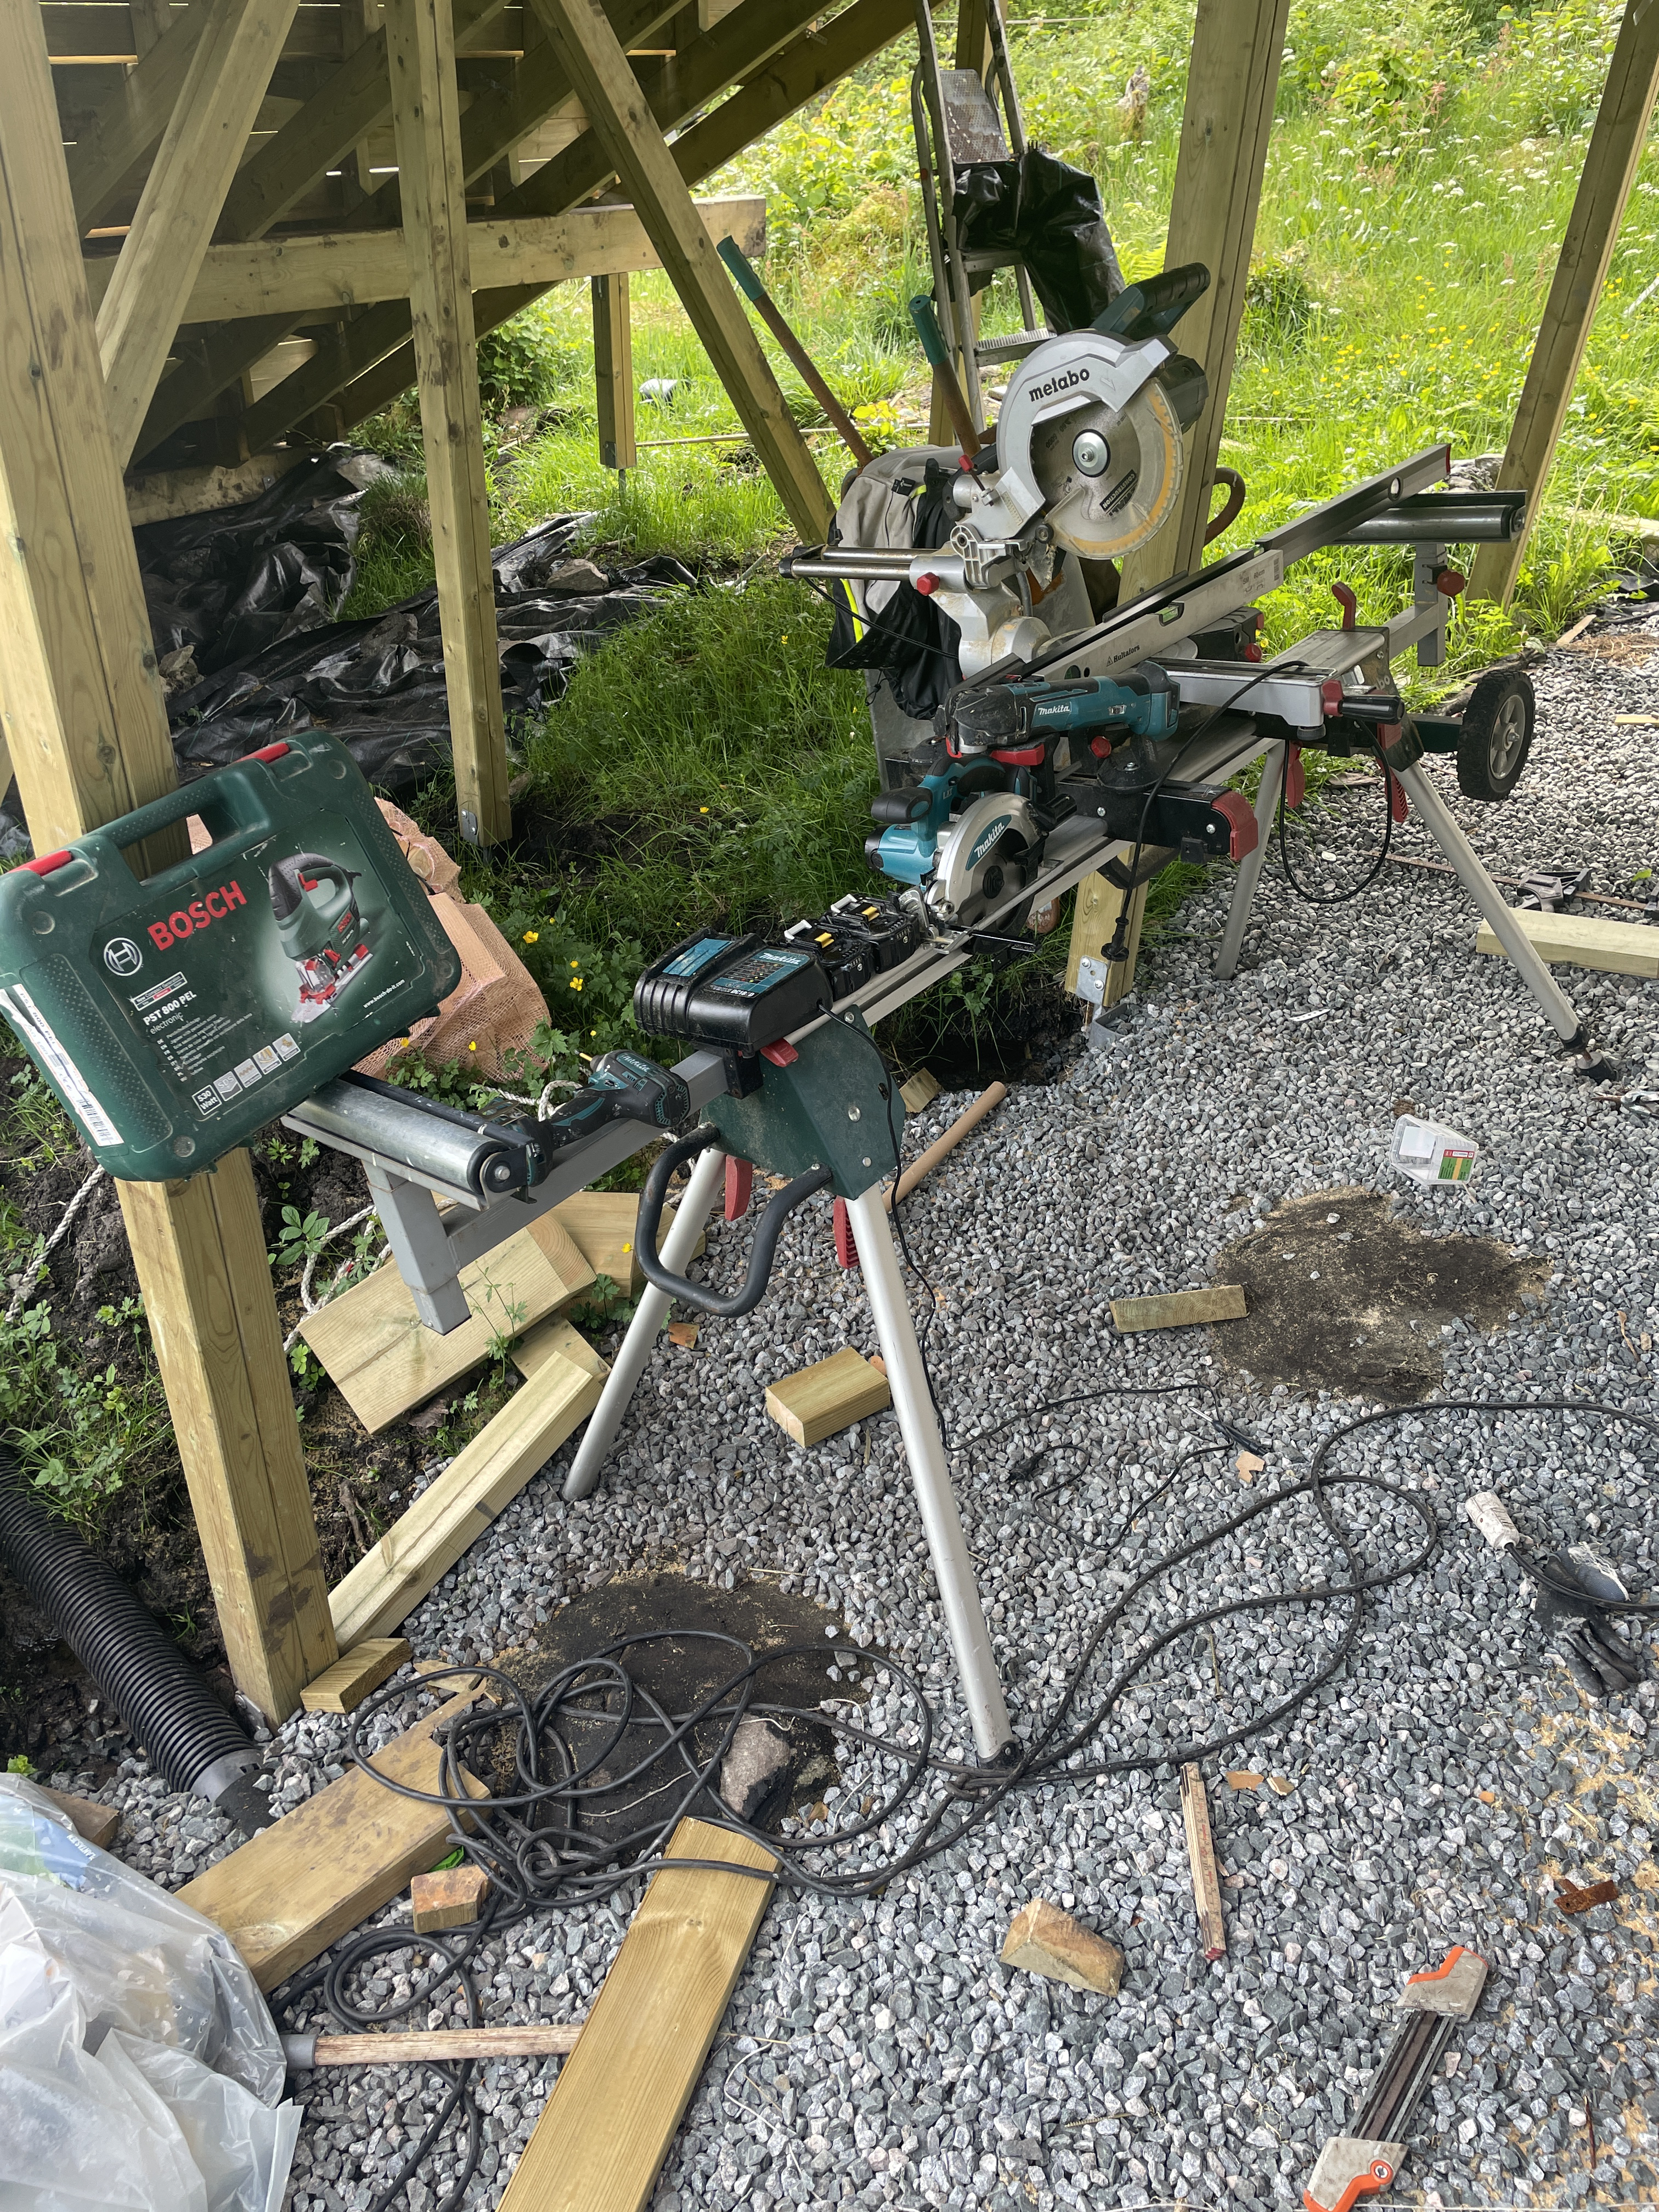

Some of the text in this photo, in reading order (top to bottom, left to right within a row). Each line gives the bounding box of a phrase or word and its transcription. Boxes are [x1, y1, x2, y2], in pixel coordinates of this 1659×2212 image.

[1029, 368, 1090, 402] metabo
[1103, 472, 1136, 509] CONSTRUCTION
[1113, 645, 1141, 664] Hultafors
[1038, 705, 1070, 715] makita
[943, 787, 953, 800] LXT
[974, 822, 1005, 859] makita
[147, 880, 247, 951] BOSCH
[759, 952, 802, 966] makita
[143, 1009, 163, 1025] PST
[161, 1000, 180, 1014] 800
[179, 990, 198, 1005] PEL
[150, 1012, 184, 1035] electronic
[217, 1075, 234, 1089] SDS
[196, 1090, 212, 1102] 530
[199, 1097, 218, 1110] Watt
